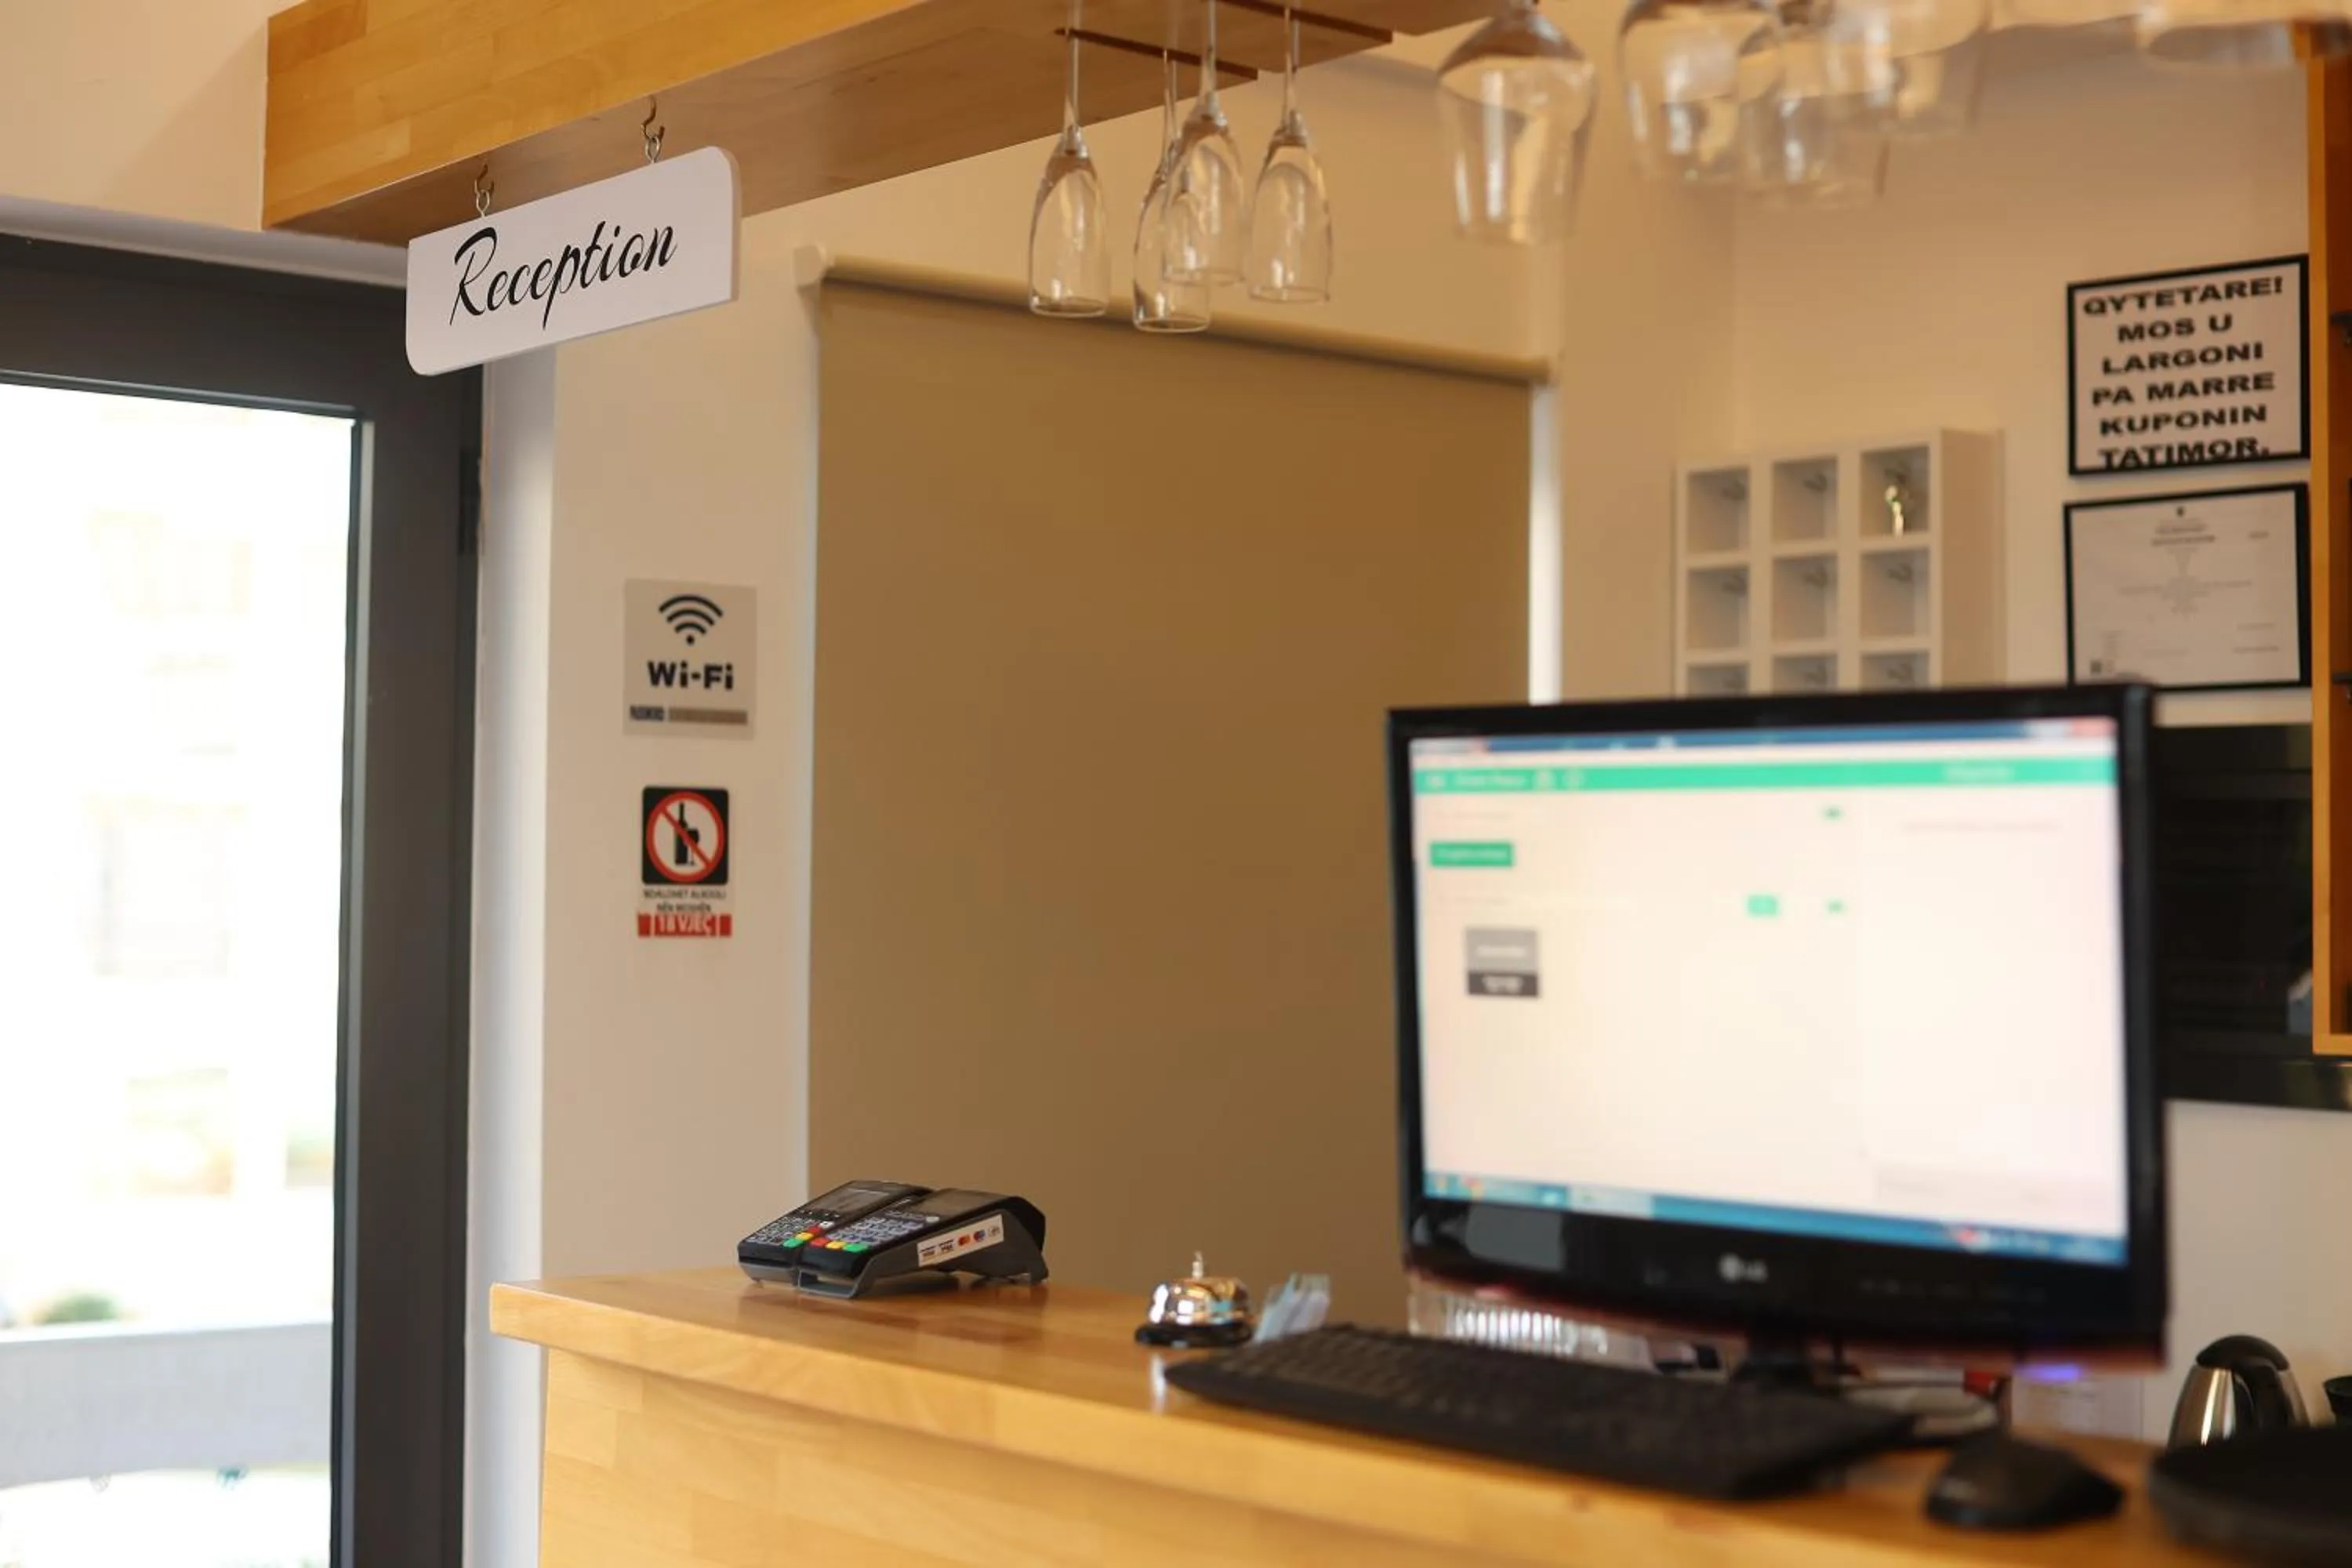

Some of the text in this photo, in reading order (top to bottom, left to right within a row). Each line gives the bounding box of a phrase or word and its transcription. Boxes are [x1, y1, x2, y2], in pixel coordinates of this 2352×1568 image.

[450, 220, 677, 328] Reception
[2083, 276, 2283, 315] QYTETARE!
[2118, 314, 2233, 343] MOS U
[2102, 341, 2263, 375] LARGONI
[2092, 372, 2276, 406] PA MARRE
[2100, 404, 2267, 437] KUPONIN
[647, 660, 734, 691] Wi-Fi
